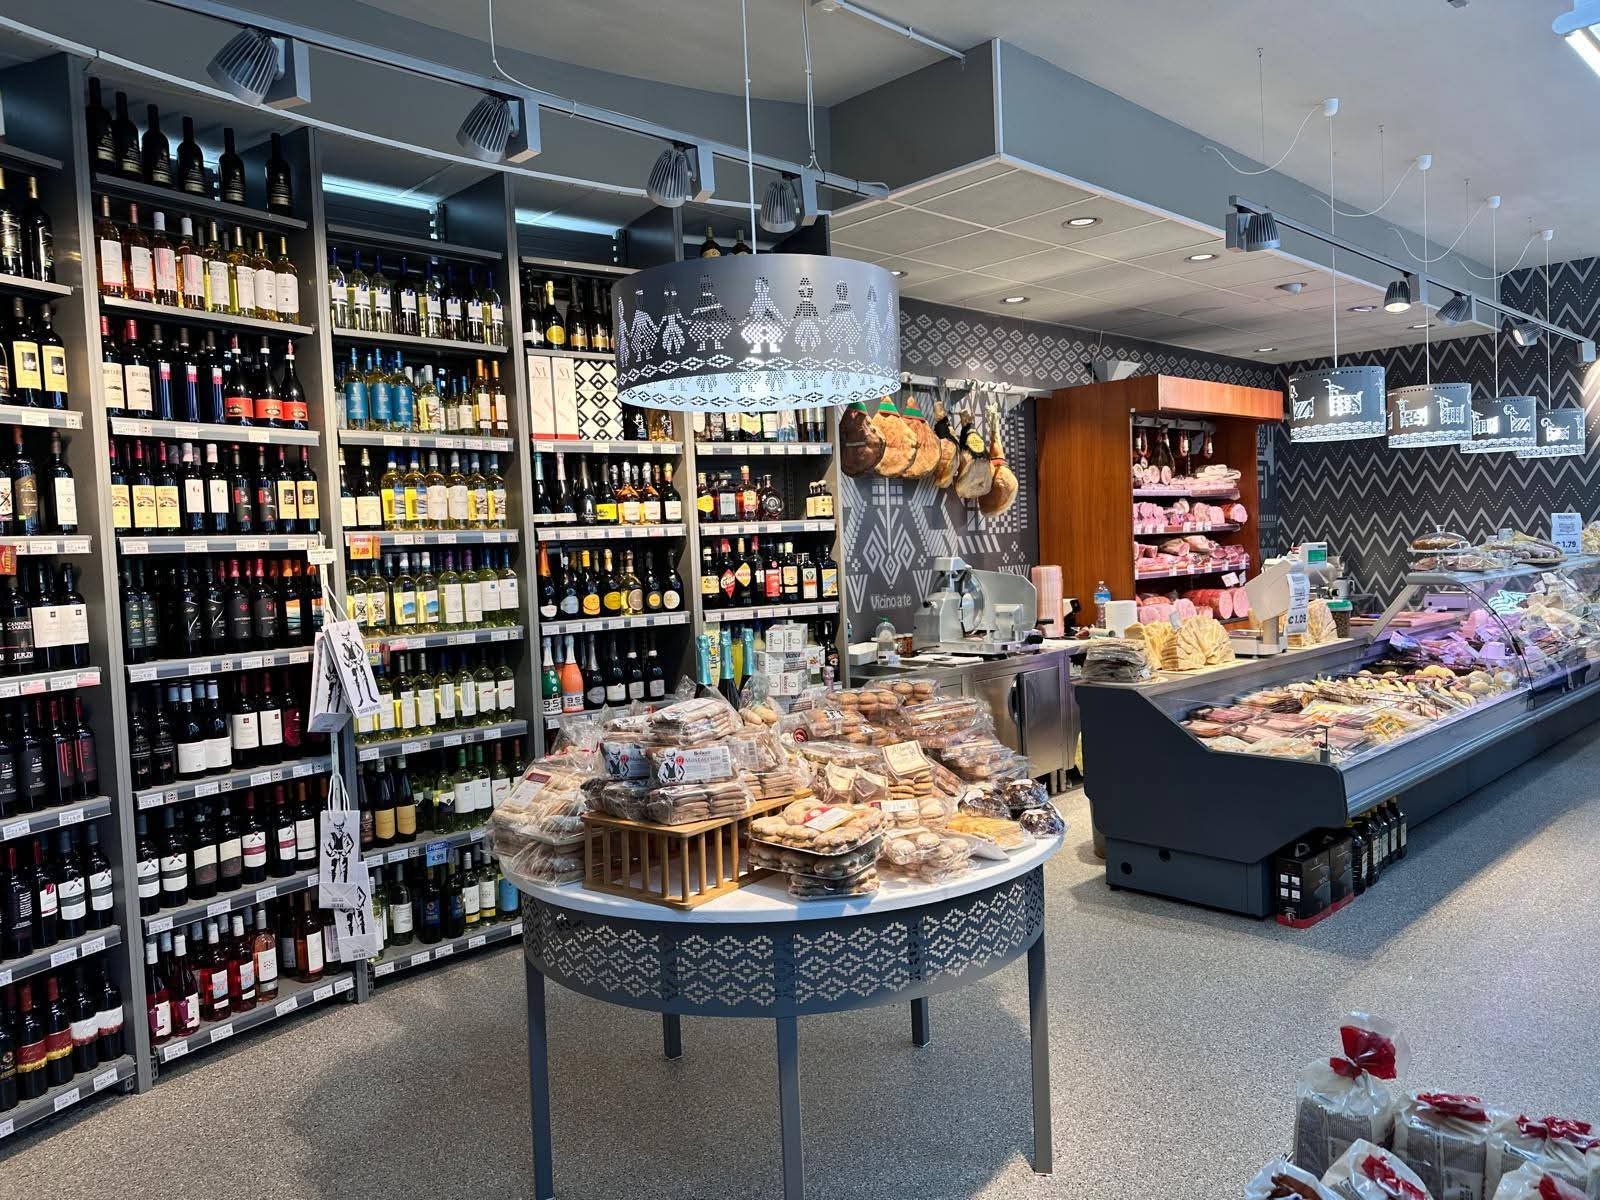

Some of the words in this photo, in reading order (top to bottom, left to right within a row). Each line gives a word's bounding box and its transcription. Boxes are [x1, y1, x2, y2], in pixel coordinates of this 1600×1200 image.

[1562, 540, 1577, 548] 1.79
[871, 594, 896, 609] Vicino
[897, 597, 902, 607] a
[903, 594, 912, 606] te
